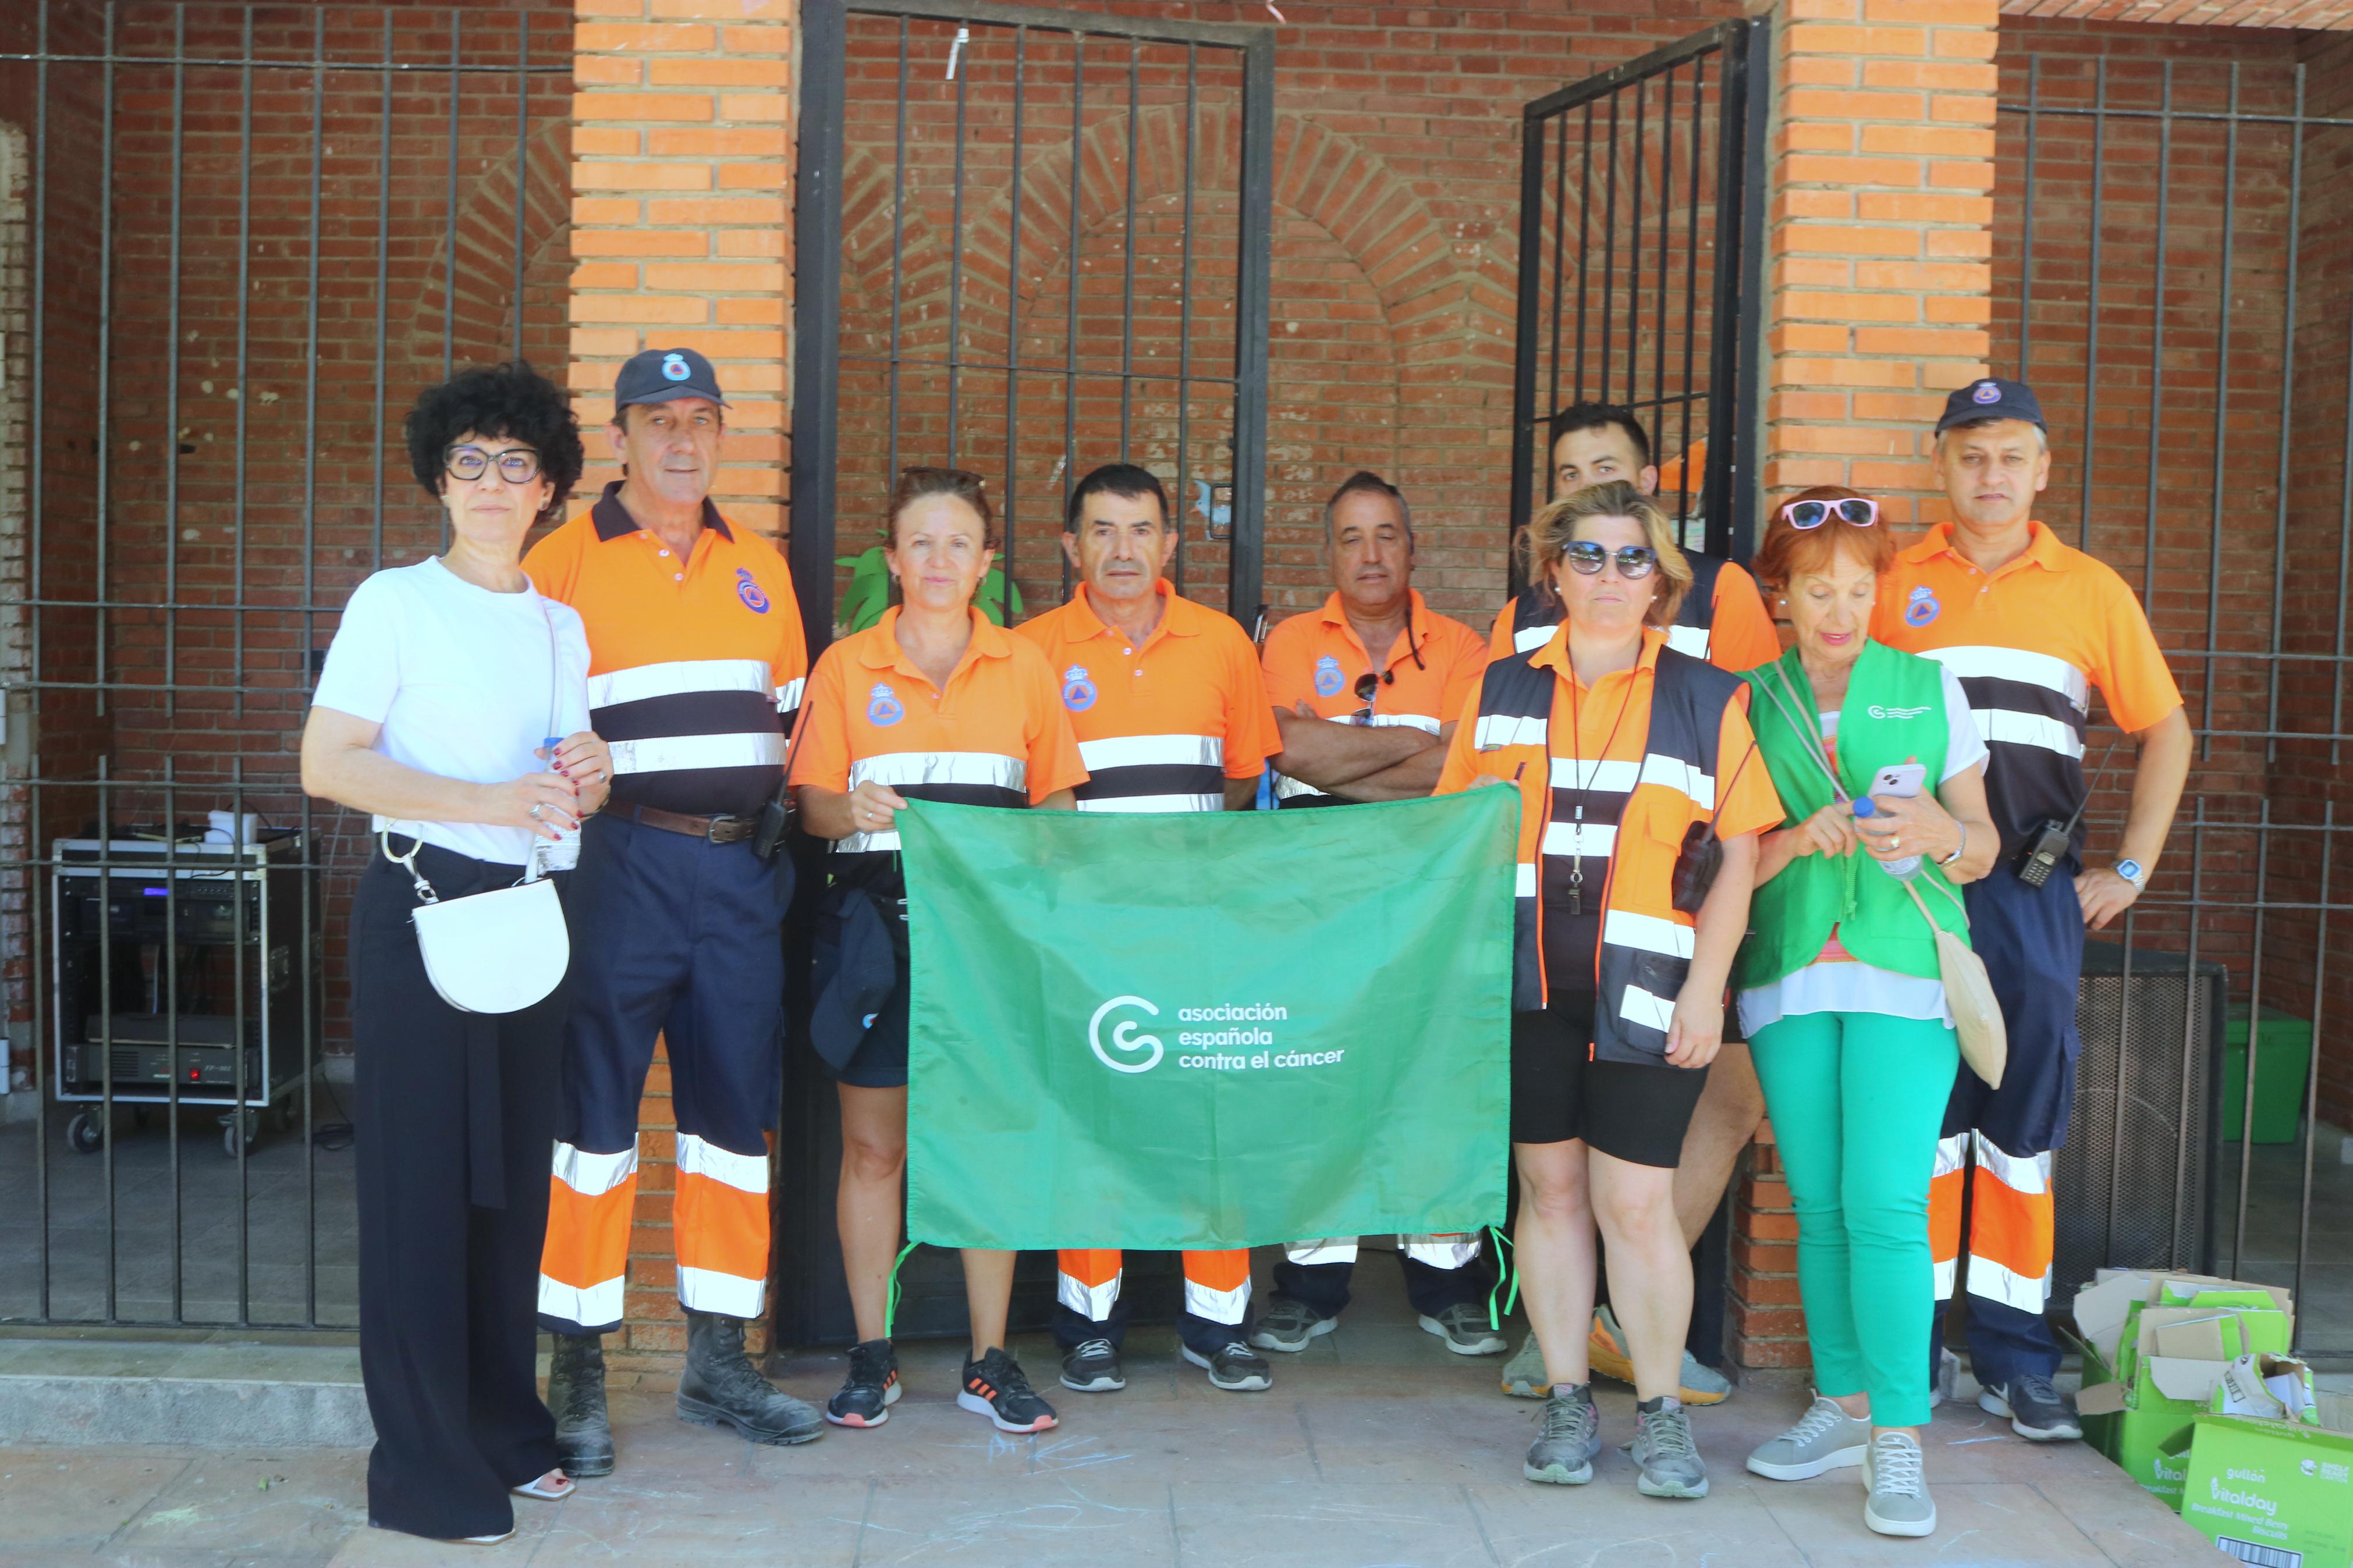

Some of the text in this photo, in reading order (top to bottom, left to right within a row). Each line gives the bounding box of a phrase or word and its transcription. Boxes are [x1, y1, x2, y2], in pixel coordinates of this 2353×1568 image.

[1177, 1002, 1288, 1022] asociación
[1178, 1026, 1273, 1050] española
[1178, 1049, 1345, 1070] contra el cáncer
[2191, 1502, 2234, 1519] Breakfast
